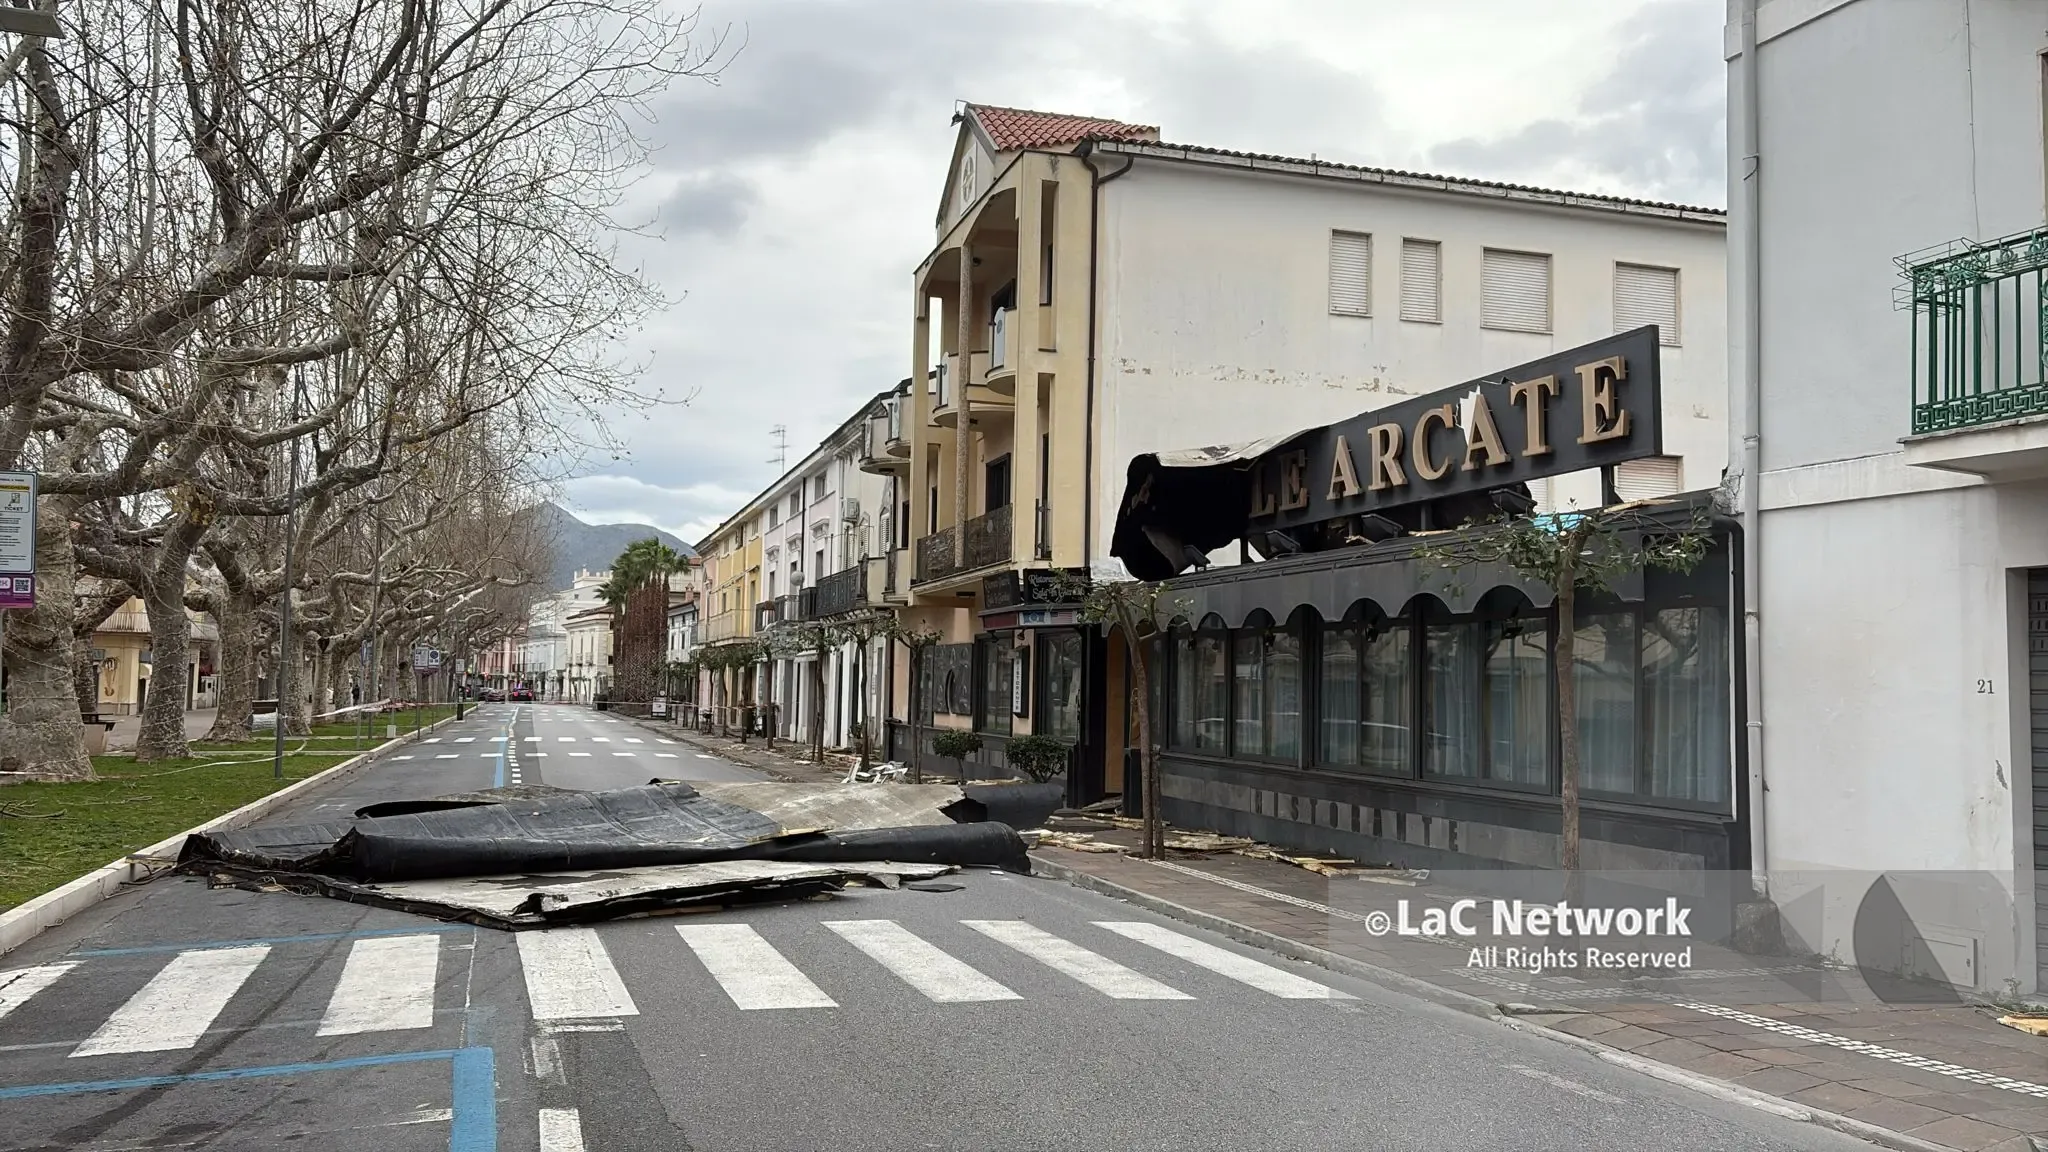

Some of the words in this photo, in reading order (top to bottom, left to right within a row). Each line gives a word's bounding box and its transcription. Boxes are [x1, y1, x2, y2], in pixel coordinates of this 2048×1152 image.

[1249, 450, 1308, 519] LE
[1326, 355, 1632, 501] ARCATE
[1976, 679, 1995, 695] 21
